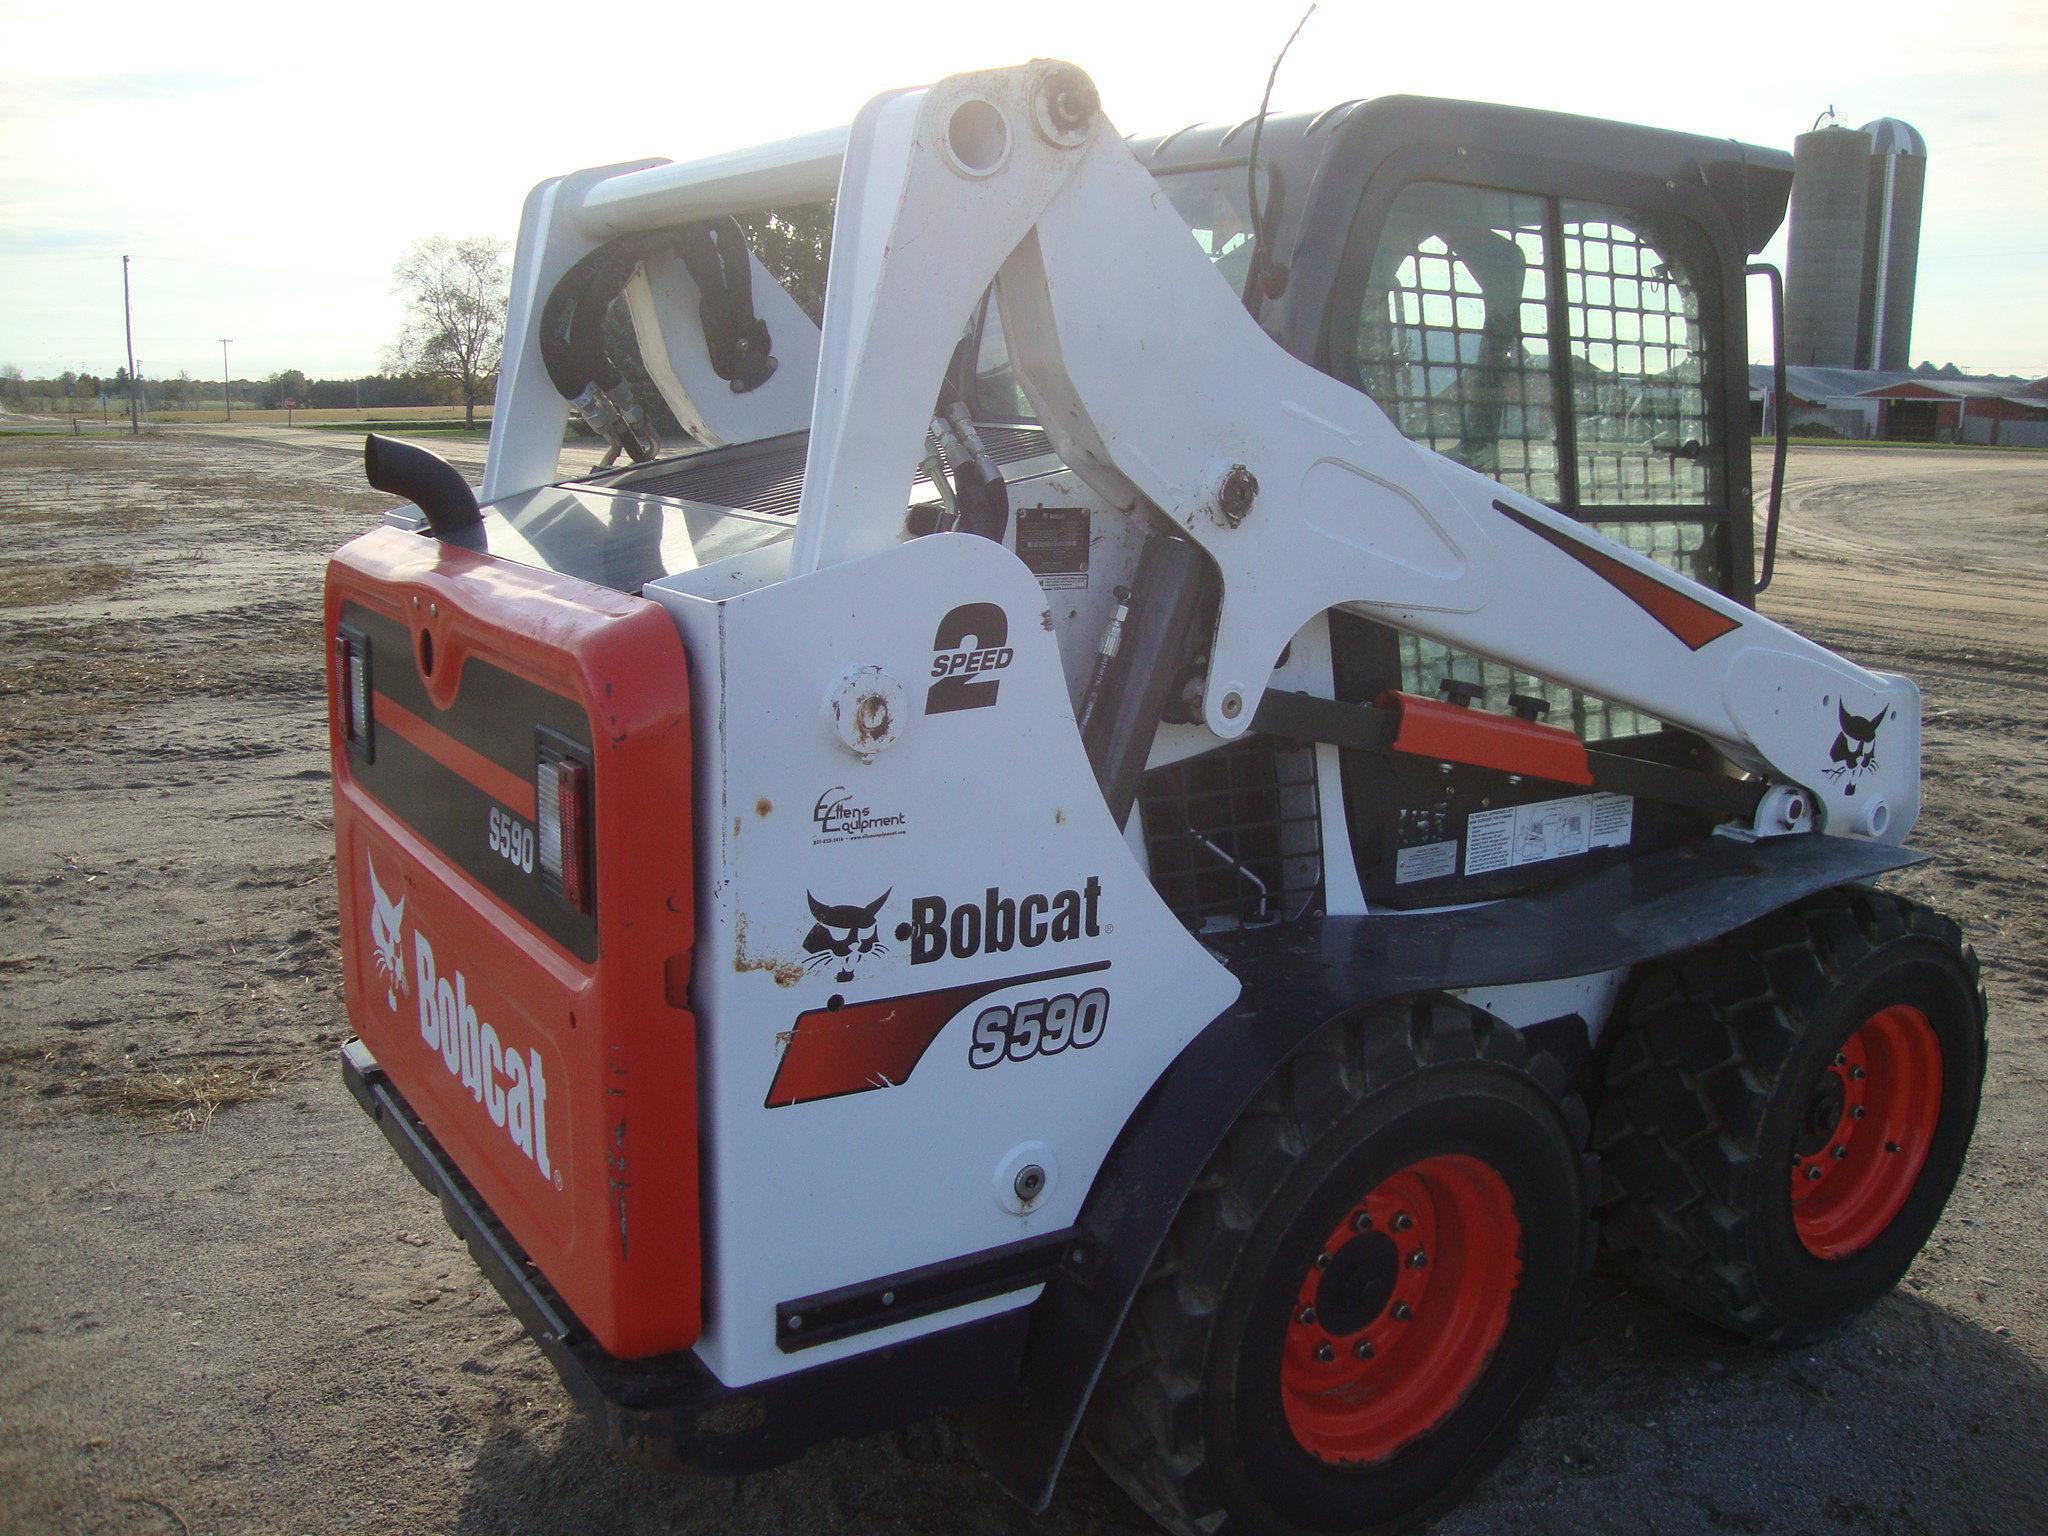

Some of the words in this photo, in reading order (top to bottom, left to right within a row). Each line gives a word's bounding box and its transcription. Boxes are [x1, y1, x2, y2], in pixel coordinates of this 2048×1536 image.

[925, 602, 1009, 715] 2
[930, 648, 1014, 678] SPEED
[488, 806, 535, 875] S590
[822, 795, 906, 834] Equipment
[910, 875, 1102, 966] Bobcat
[414, 928, 551, 1181] Bobcat
[968, 987, 1111, 1070] S590
